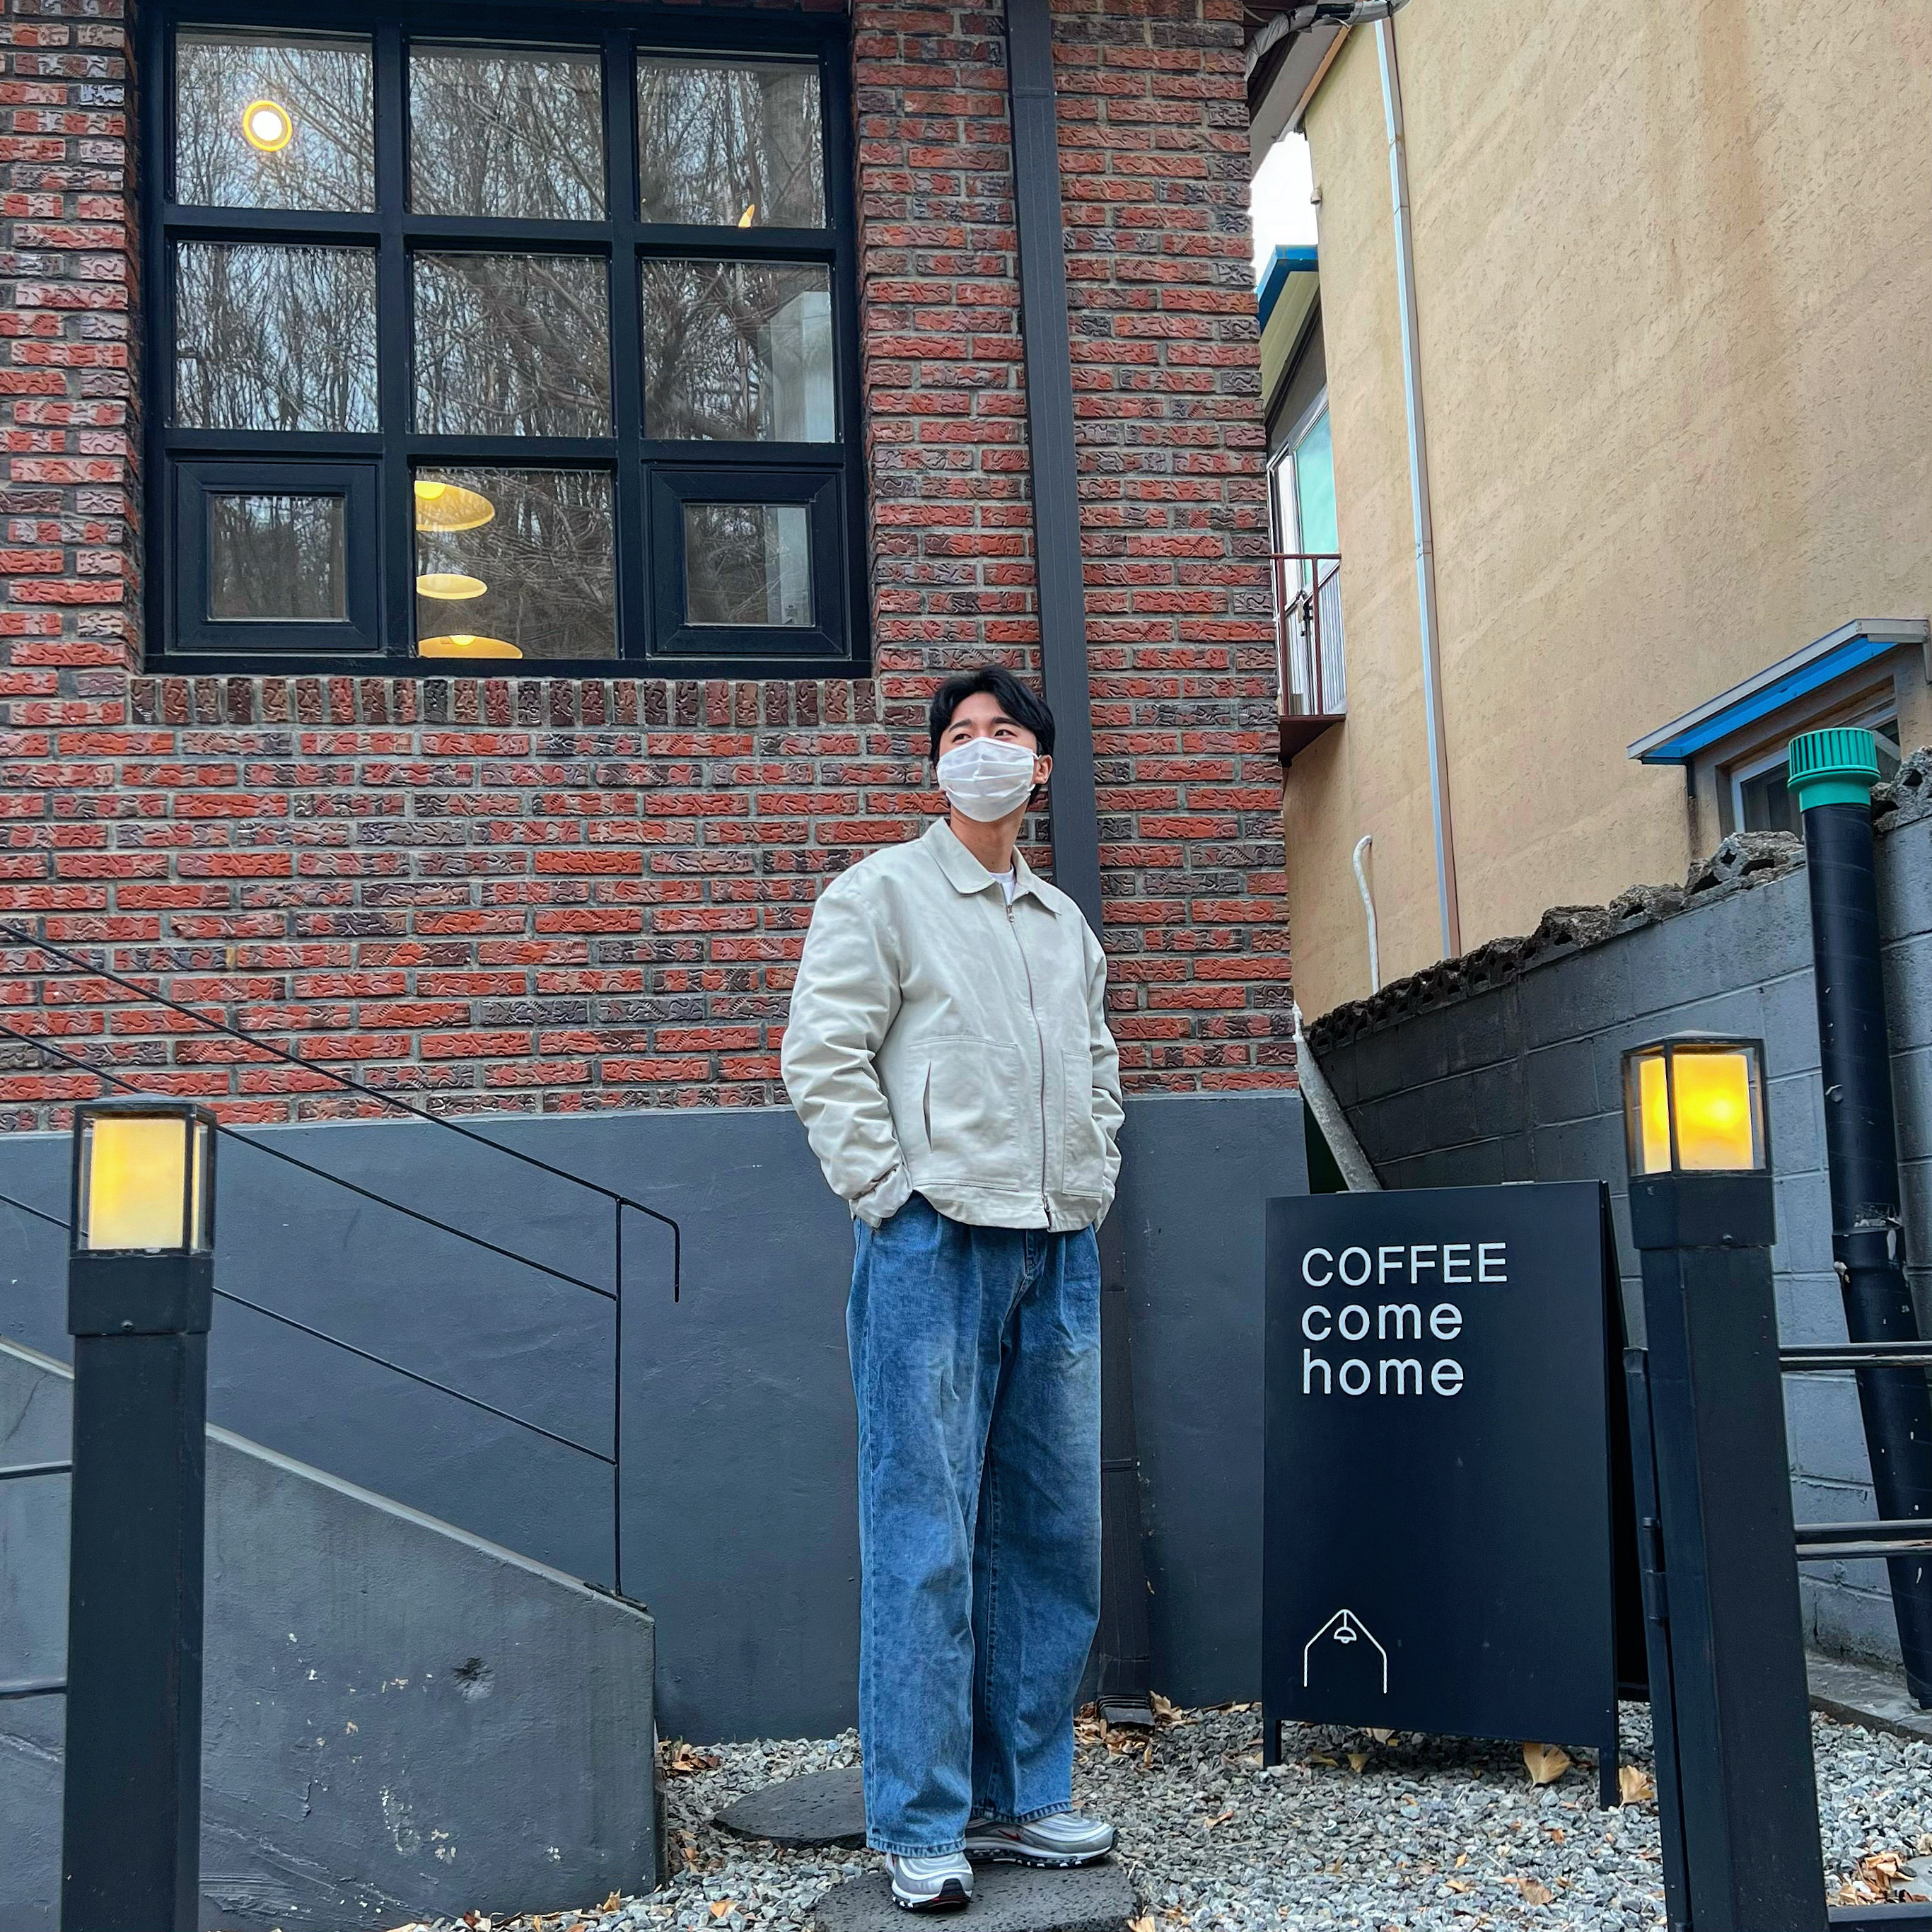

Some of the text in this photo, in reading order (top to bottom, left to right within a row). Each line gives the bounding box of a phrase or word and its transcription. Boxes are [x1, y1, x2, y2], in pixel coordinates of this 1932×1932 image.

[1301, 1241, 1508, 1287] COFFEE
[1300, 1303, 1463, 1342] come
[1303, 1347, 1465, 1397] home
